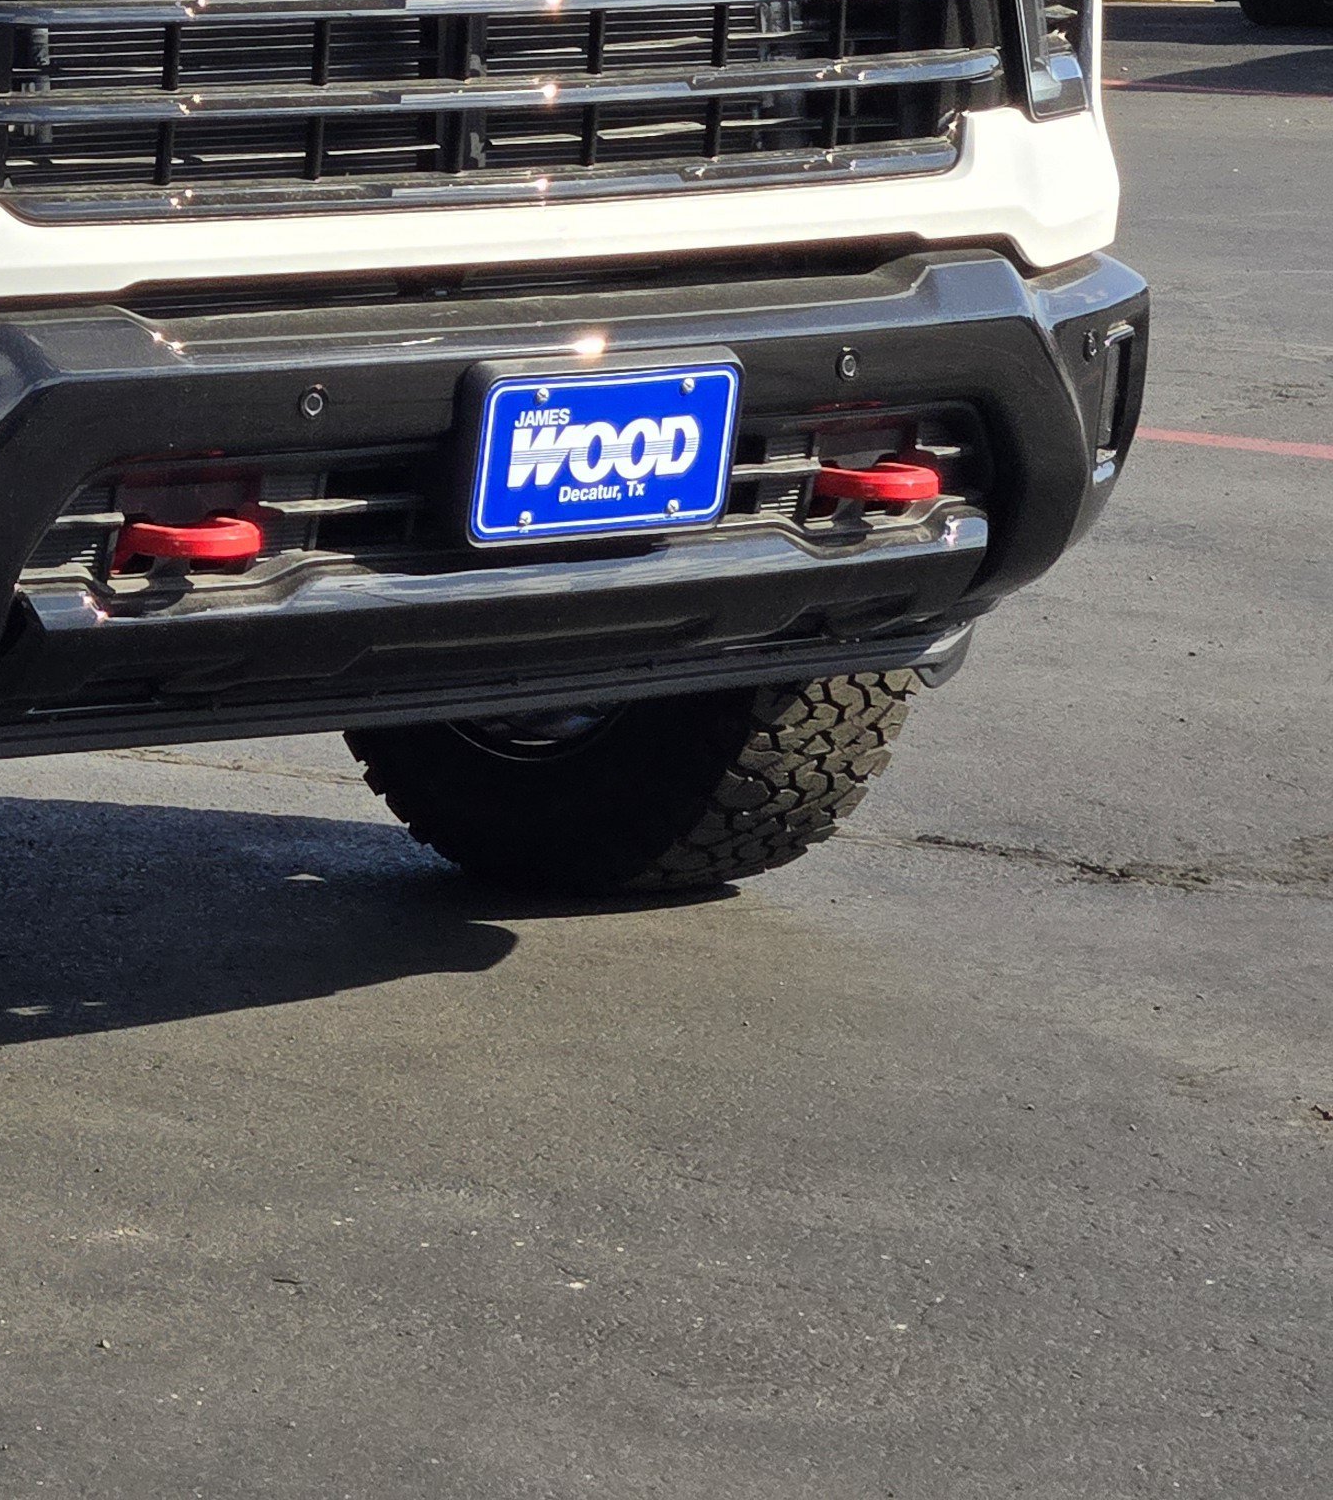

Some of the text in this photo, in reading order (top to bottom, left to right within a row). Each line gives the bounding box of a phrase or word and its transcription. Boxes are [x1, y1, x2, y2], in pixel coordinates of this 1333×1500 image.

[514, 407, 571, 428] JAMES
[506, 415, 701, 489] WOOD
[558, 480, 645, 504] Decatur, Tx
